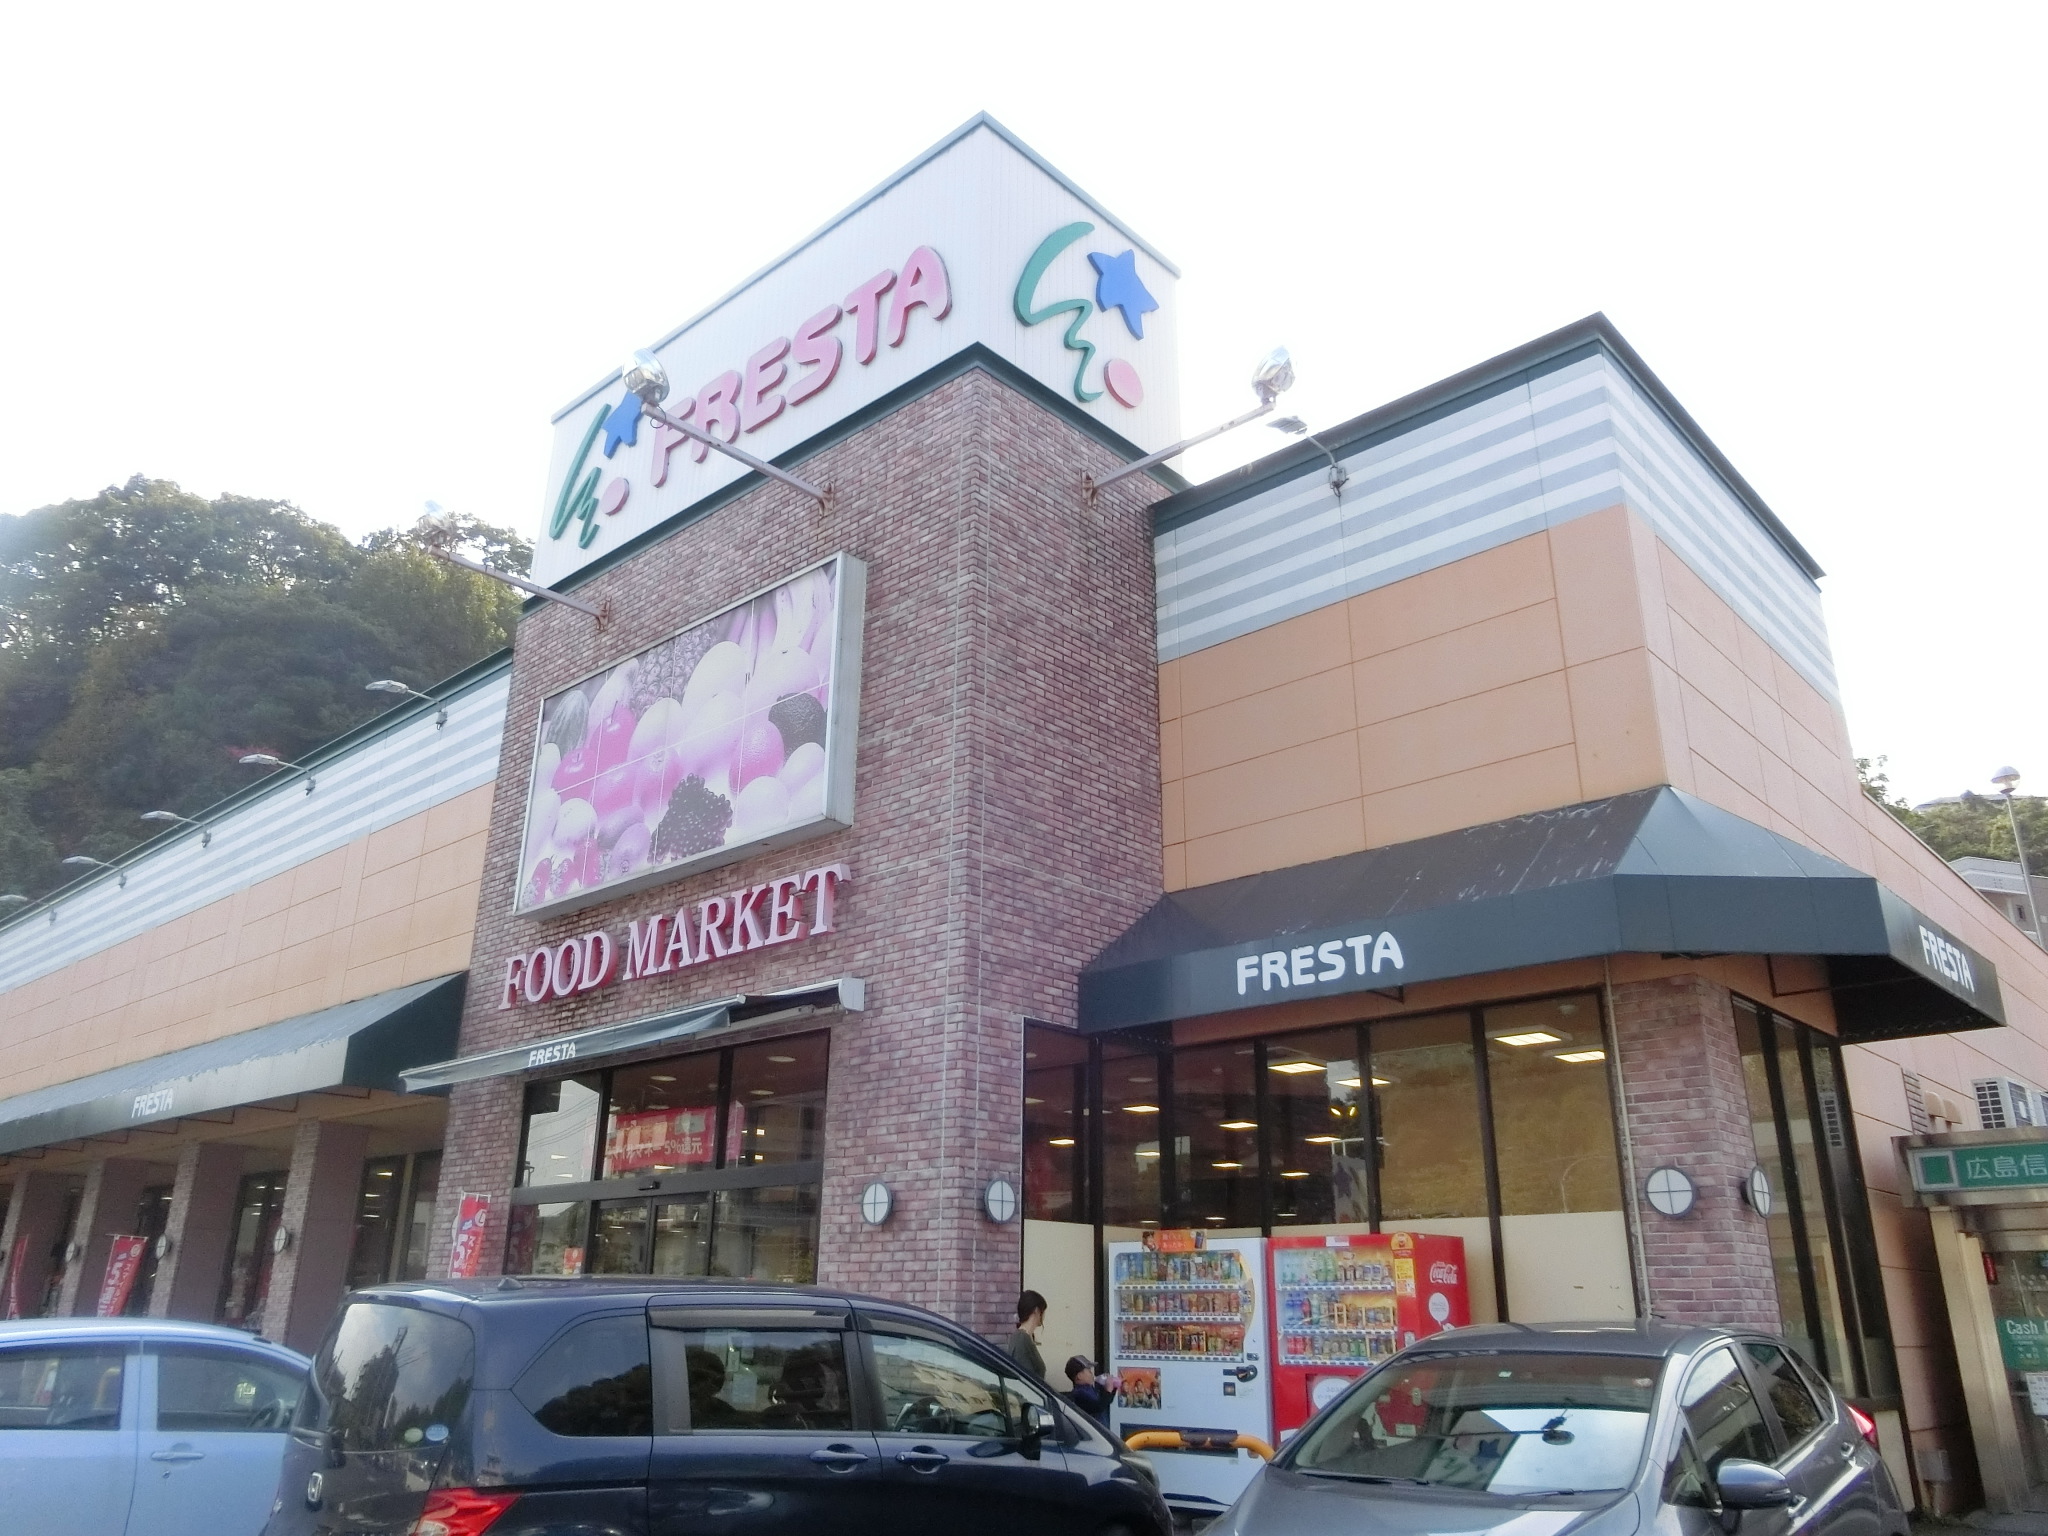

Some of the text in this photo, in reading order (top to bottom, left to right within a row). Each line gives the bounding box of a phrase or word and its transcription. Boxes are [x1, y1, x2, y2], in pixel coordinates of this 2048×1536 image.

[650, 245, 952, 488] FRESTA
[499, 863, 852, 1010] FOOD MARKET
[1918, 925, 1976, 993] FRESTA
[1236, 931, 1405, 995] FRESTA
[527, 1041, 577, 1068] FRESTA
[131, 1086, 174, 1119] FRESTA
[1966, 1153, 2048, 1179] 広島信
[2006, 1320, 2039, 1335] Cash
